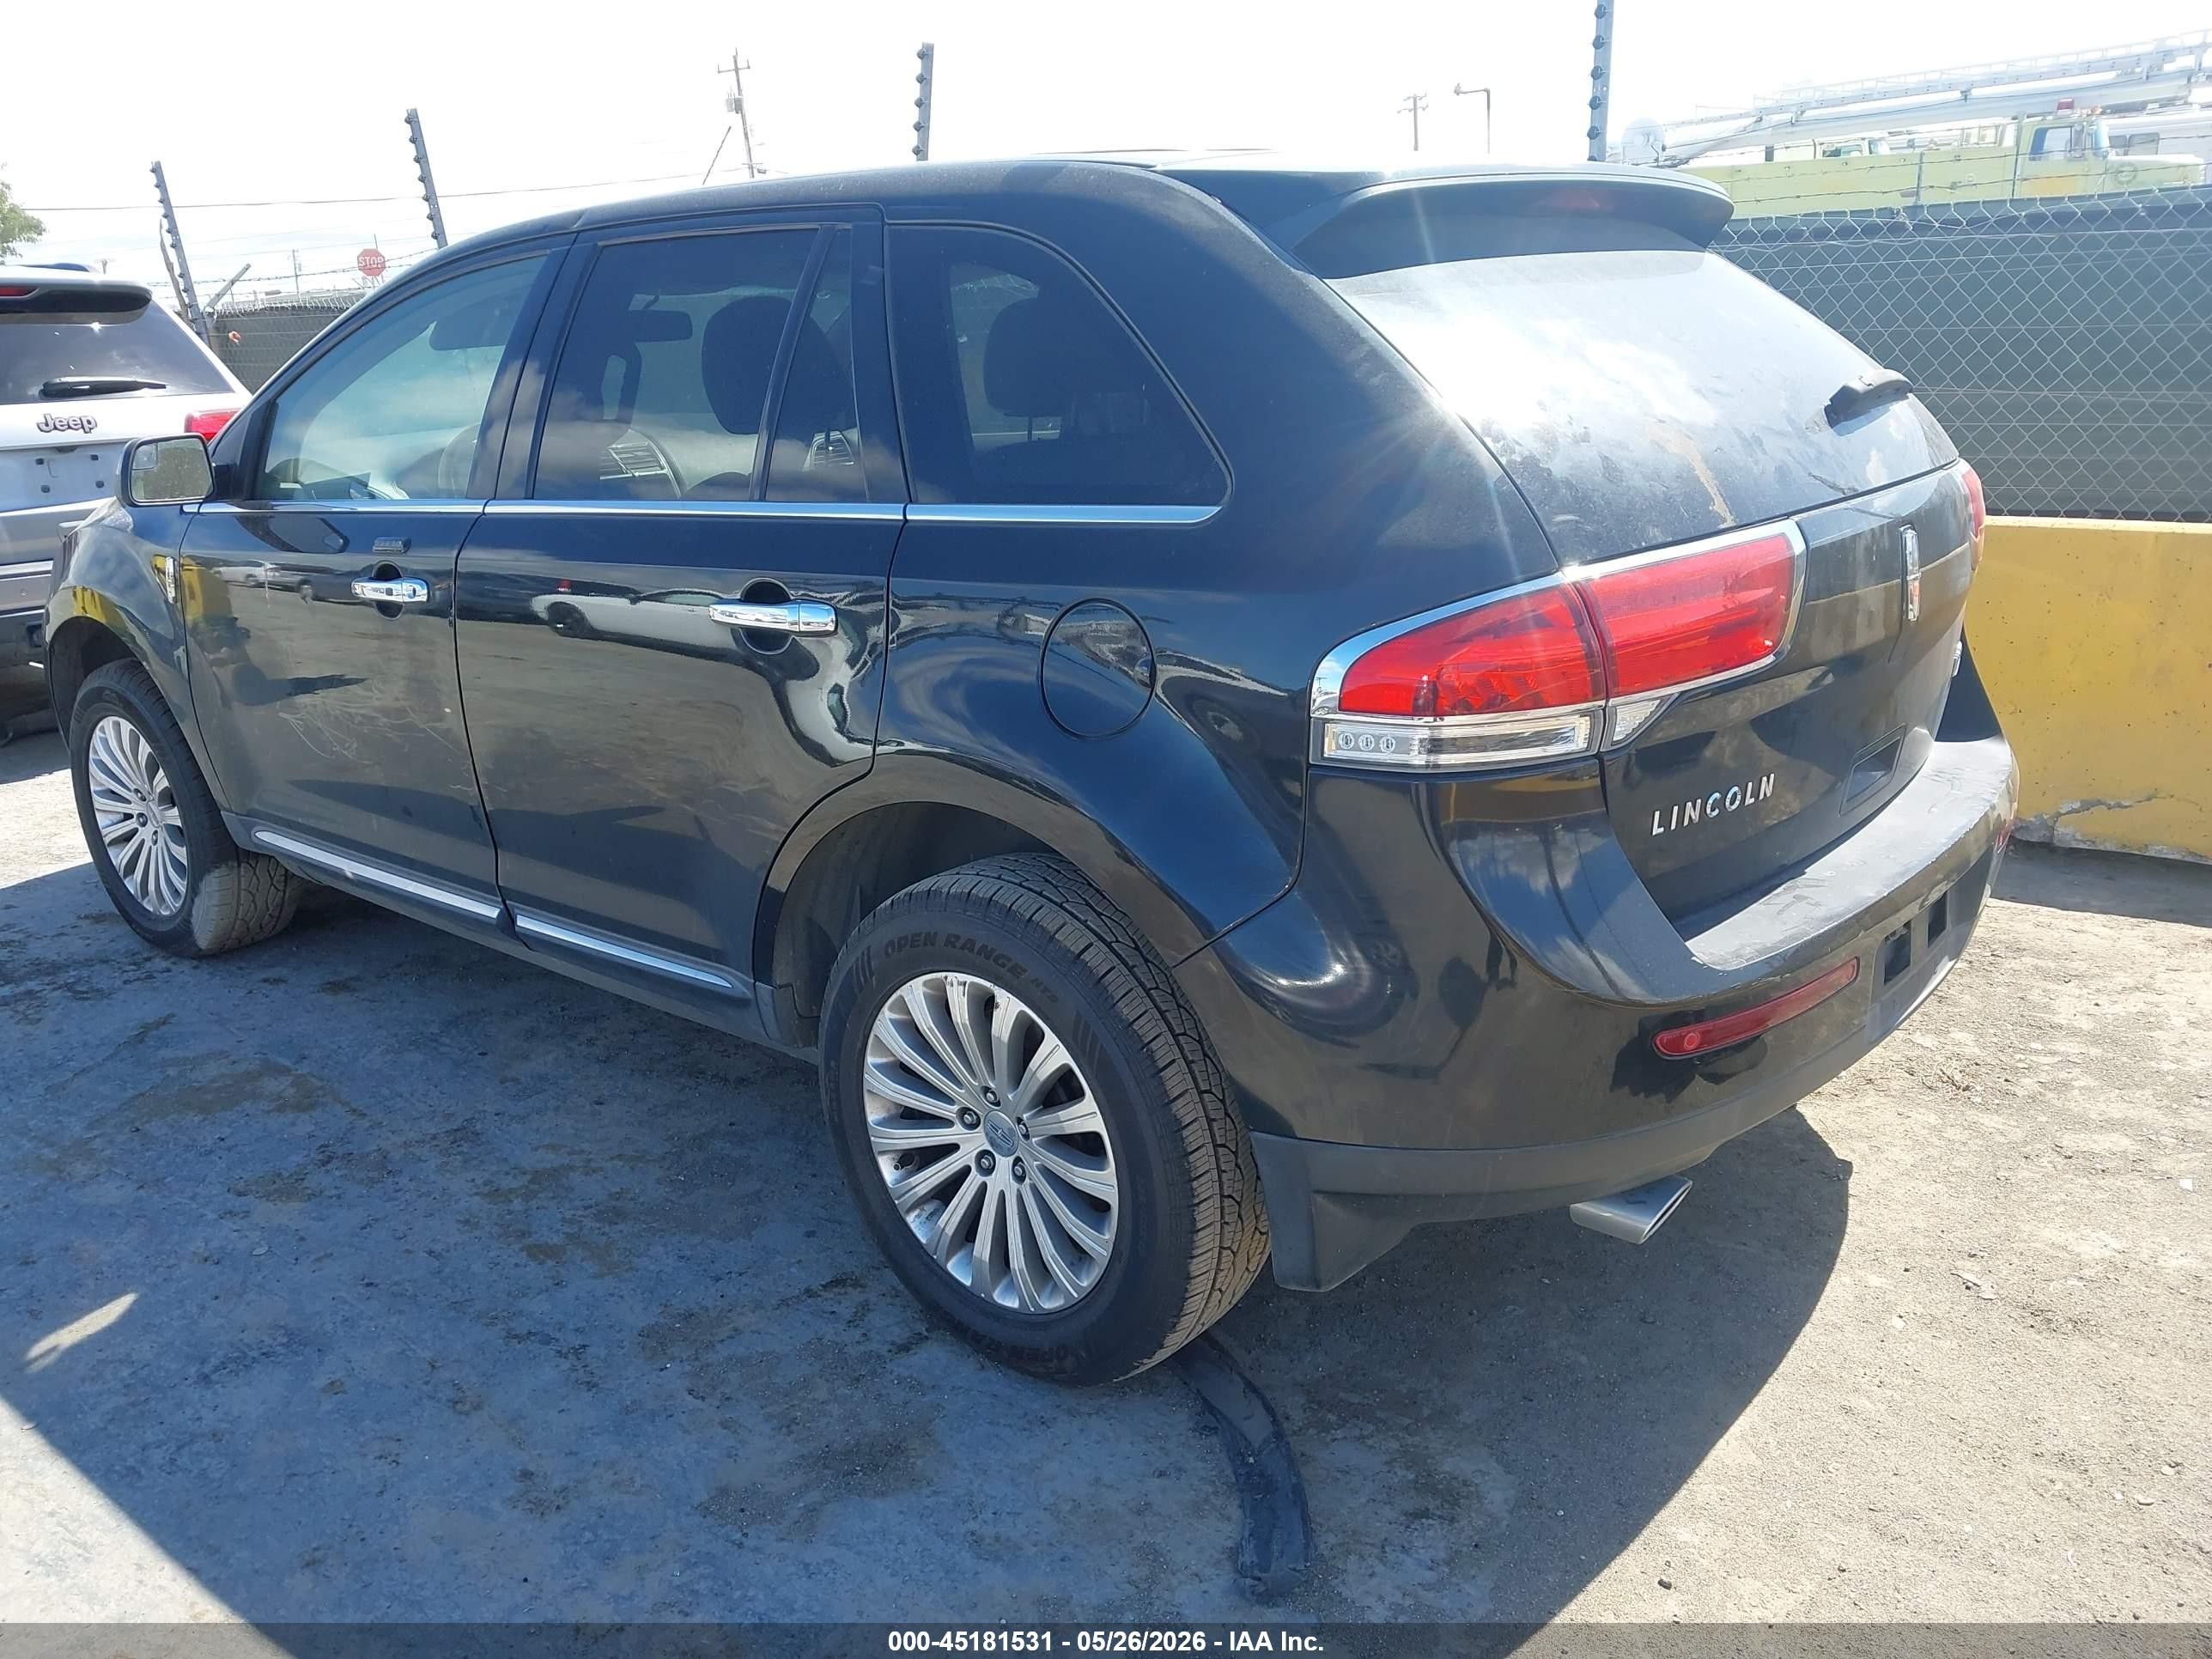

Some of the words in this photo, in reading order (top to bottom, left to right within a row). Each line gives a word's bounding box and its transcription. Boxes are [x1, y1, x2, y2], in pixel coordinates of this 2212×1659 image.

[359, 256, 384, 268] STOP
[36, 413, 98, 434] Jeep
[1651, 773, 1775, 836] LINCOLN
[884, 931, 939, 957] OPEN
[944, 933, 1030, 977] RANGE
